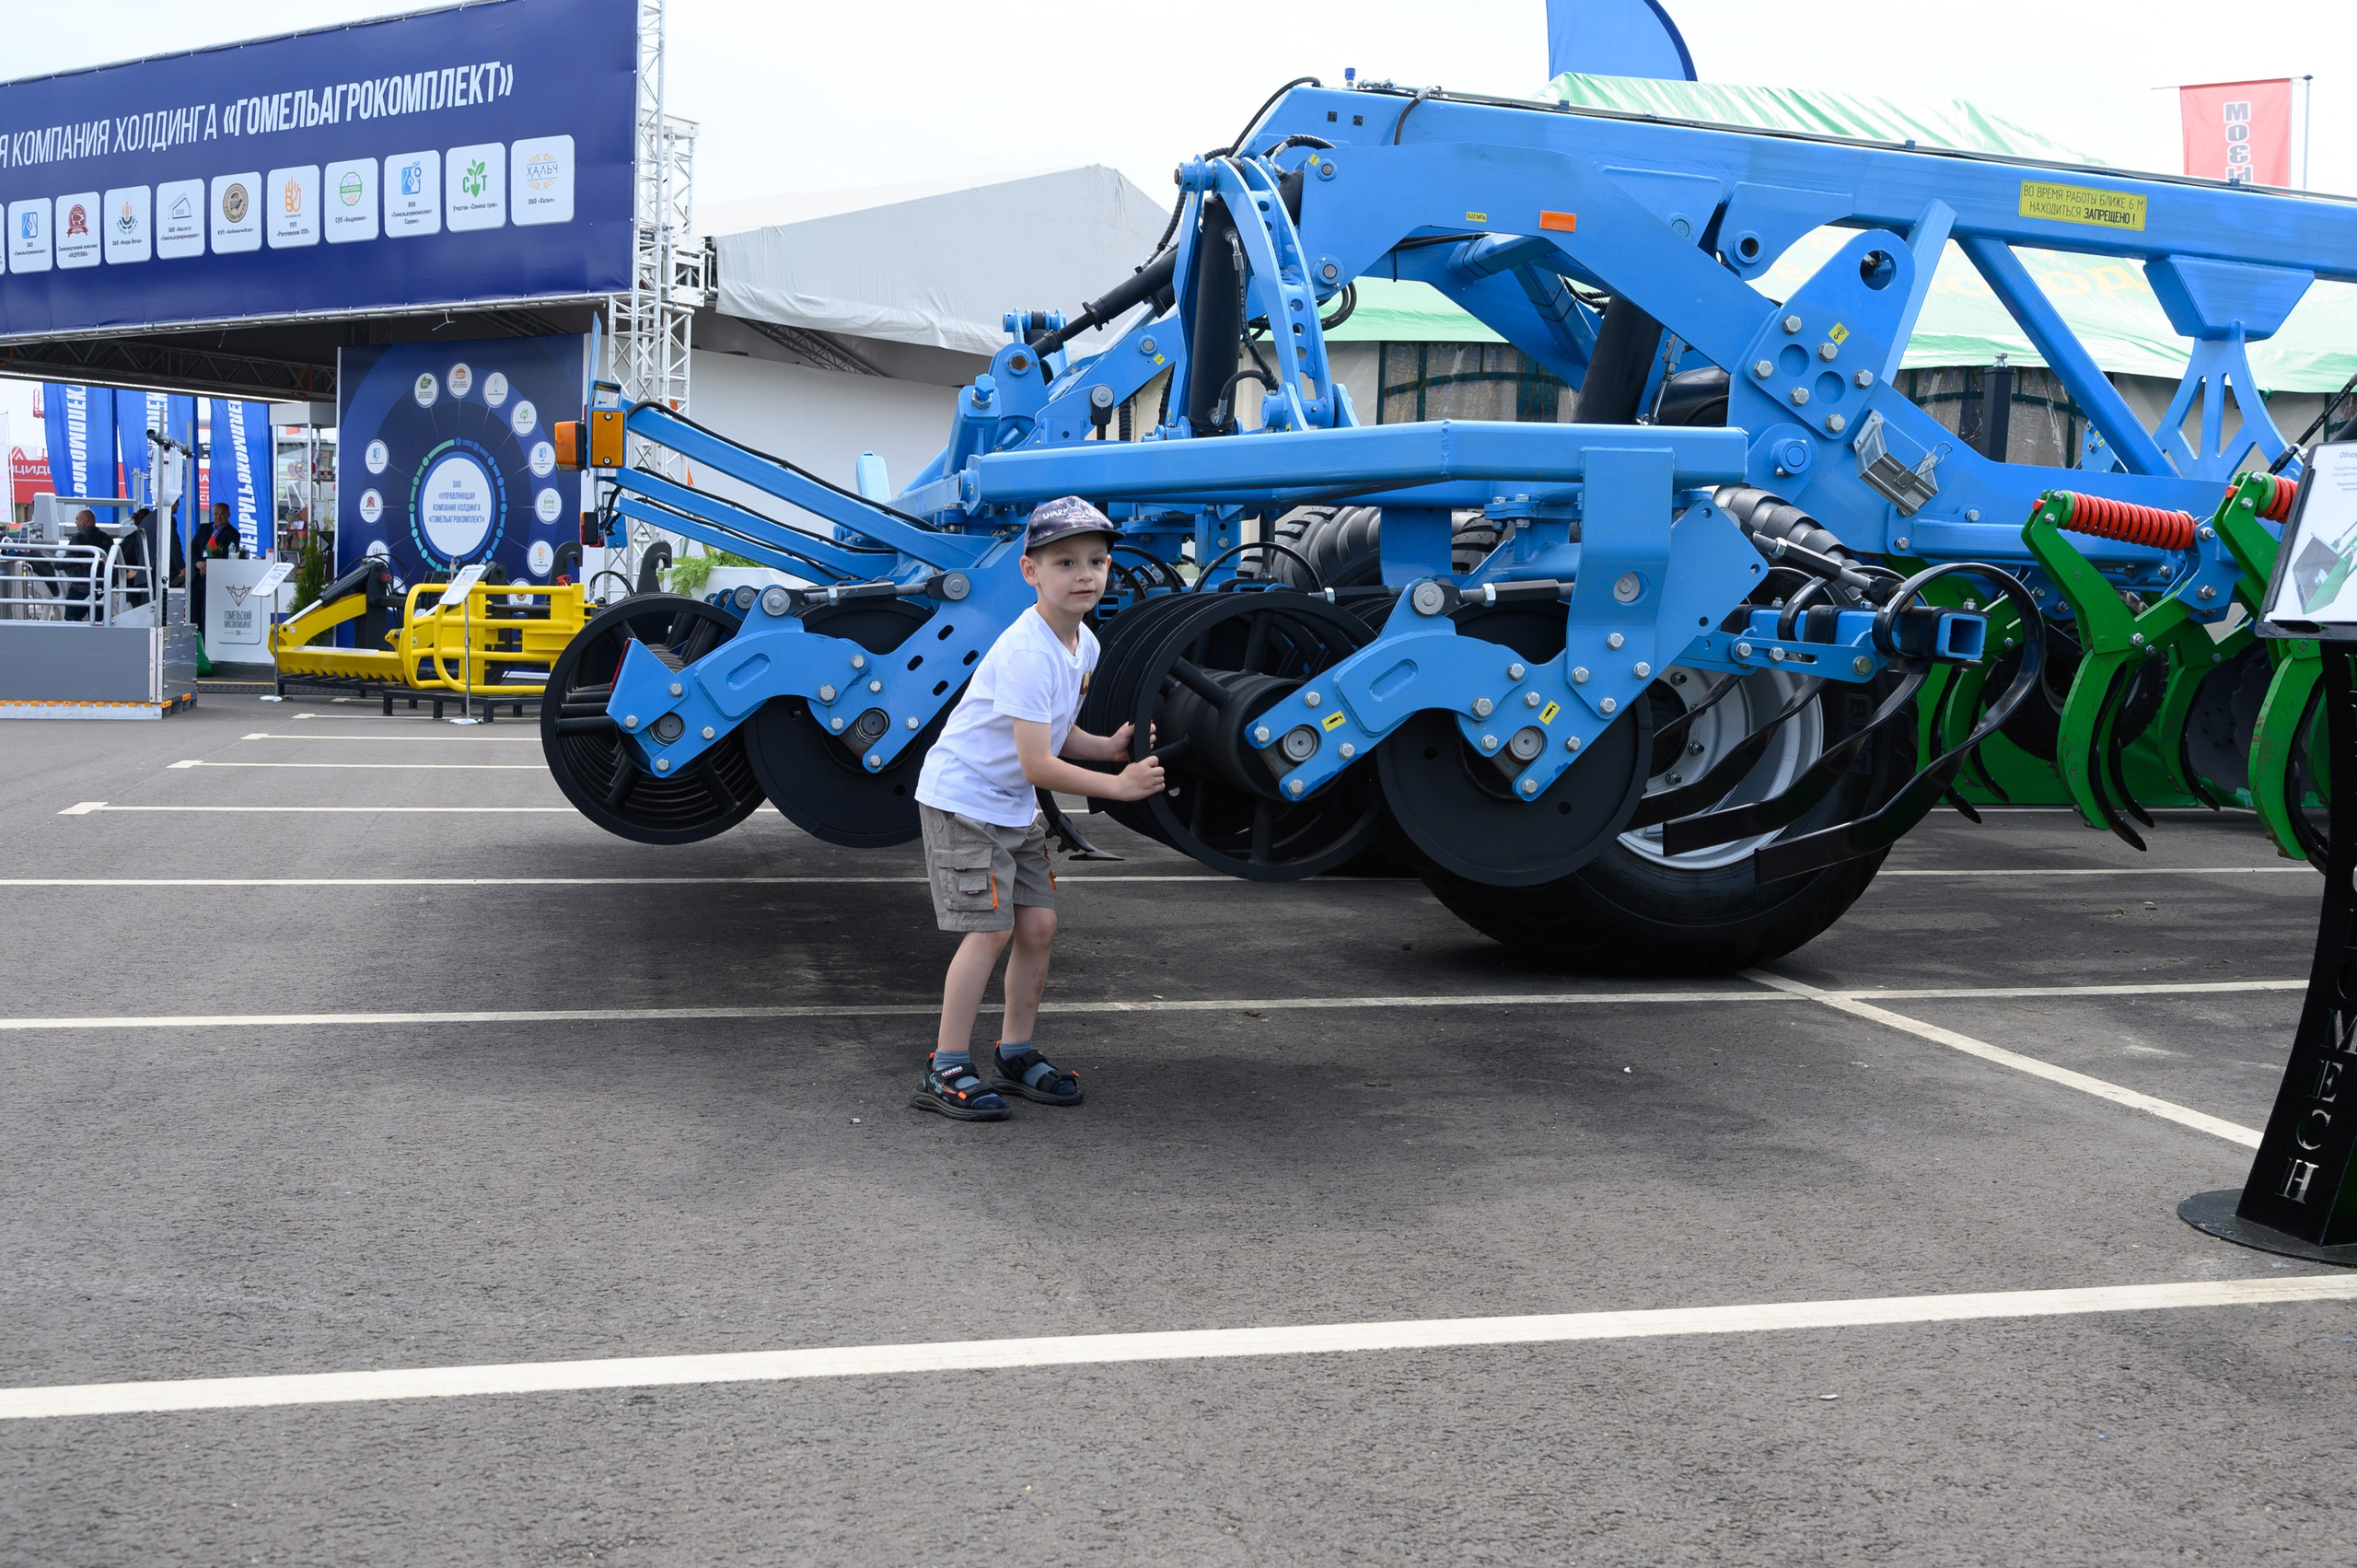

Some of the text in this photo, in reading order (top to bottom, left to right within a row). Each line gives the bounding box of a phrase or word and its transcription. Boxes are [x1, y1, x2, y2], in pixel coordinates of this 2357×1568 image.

[11, 119, 110, 168] КОМПАНИЯ
[113, 103, 217, 153] ХОЛДИНГА
[223, 61, 514, 137] «ГОМЕЛЬАГРОКОМПЛЕКТ»
[527, 164, 558, 179] ХАЛЬЧ
[2024, 184, 2143, 211] ВО ВРЕМЯ РАБОТЫ БЛИЖЕ 6 М
[2029, 201, 2081, 217] НАХОДИТЬСЯ
[2084, 207, 2131, 225] ЗАПРЕЩЕНО
[452, 480, 462, 488] ОАО
[433, 503, 482, 512] КОМПАНИЯ ХОЛДИНГА
